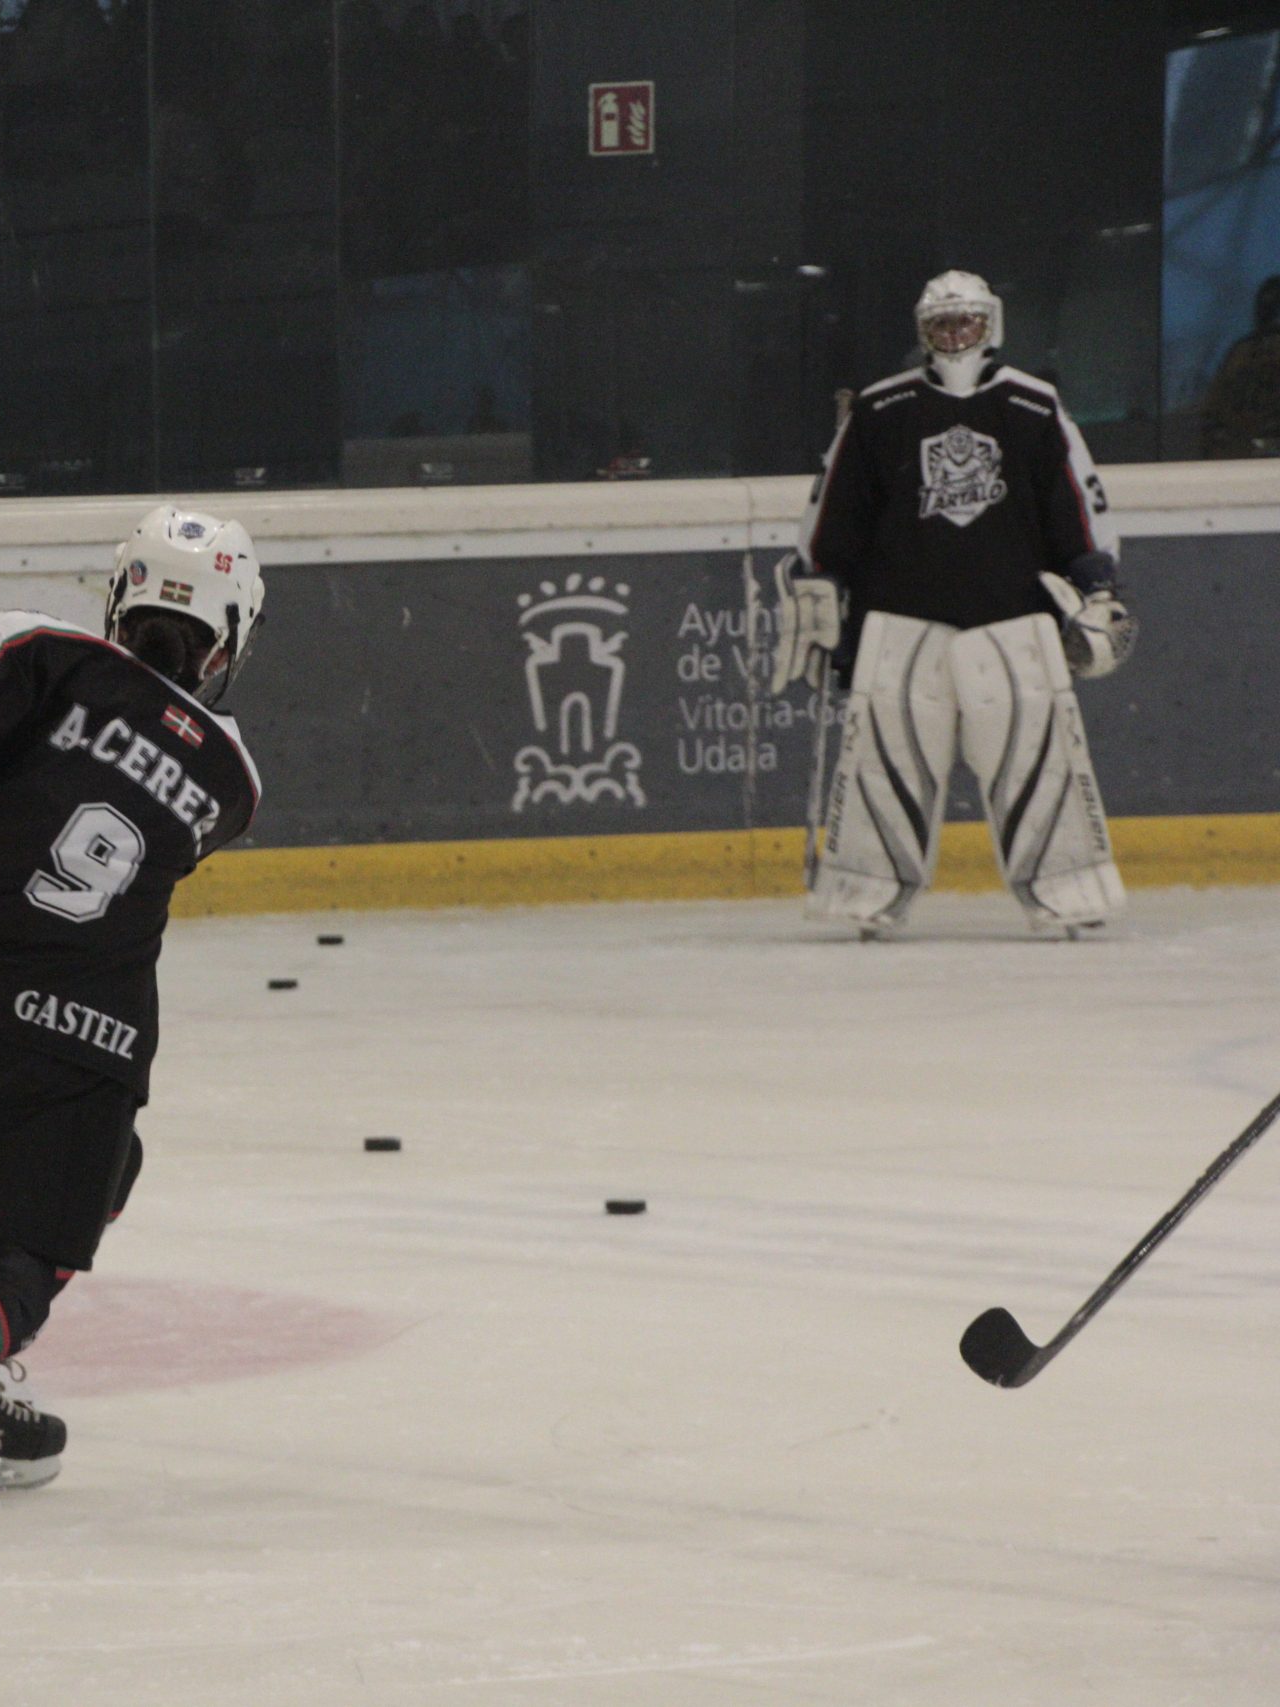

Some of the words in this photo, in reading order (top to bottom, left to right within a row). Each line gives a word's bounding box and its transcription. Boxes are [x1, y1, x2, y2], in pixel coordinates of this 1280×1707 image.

[677, 643, 722, 682] de
[23, 802, 146, 923] 9
[14, 989, 138, 1060] GASTEIZ
